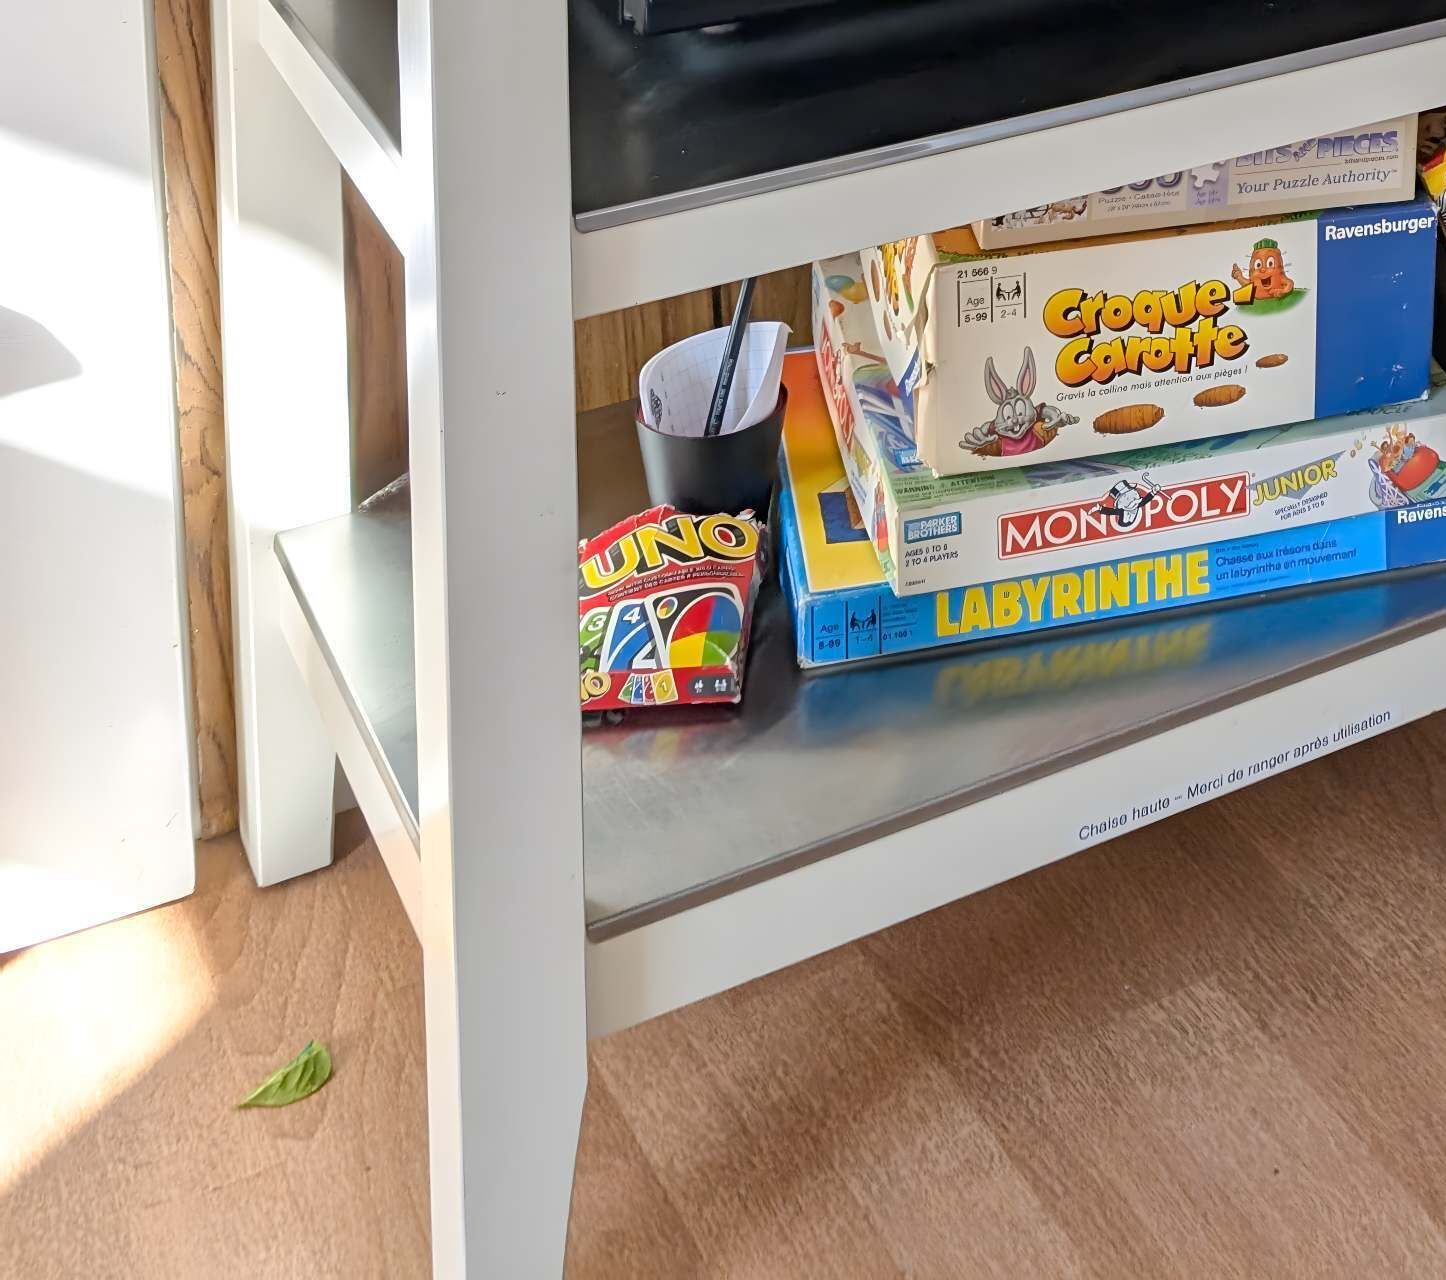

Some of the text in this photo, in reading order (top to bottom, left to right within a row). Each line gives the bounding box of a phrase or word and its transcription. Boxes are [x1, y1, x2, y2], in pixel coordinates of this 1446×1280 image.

[1317, 130, 1399, 159] PIECES
[1236, 181, 1270, 194] Your
[1272, 174, 1319, 191] Puzzle
[1325, 216, 1435, 241] Ravensburger
[957, 269, 968, 279] 21
[966, 297, 985, 308] Age
[964, 312, 988, 323] 5-99
[1056, 389, 1085, 402] Gravis
[1087, 388, 1096, 398] la
[1099, 383, 1129, 396] colline
[1131, 379, 1153, 391] mais
[1154, 374, 1193, 388] attention
[1195, 373, 1212, 381] aux
[1214, 367, 1242, 380] pièges
[1005, 457, 1338, 553] MONOPOLY JUNIOR
[908, 524, 958, 540] BROTHERS
[920, 515, 957, 530] PARKER
[581, 513, 760, 590] UNO
[905, 548, 924, 558] AGES
[912, 557, 921, 566] TO
[929, 551, 959, 562] PLAYERS
[1216, 539, 1337, 567] Chasse aux trésors dans
[1216, 548, 1357, 580] un labyrinthe en mouvement
[936, 549, 1210, 638] LABYRINTHE
[587, 614, 606, 632] 3
[623, 606, 641, 623] 4
[820, 623, 839, 633] Age
[1078, 710, 1391, 841] Chaise haute Merci de ranger après utilisation
